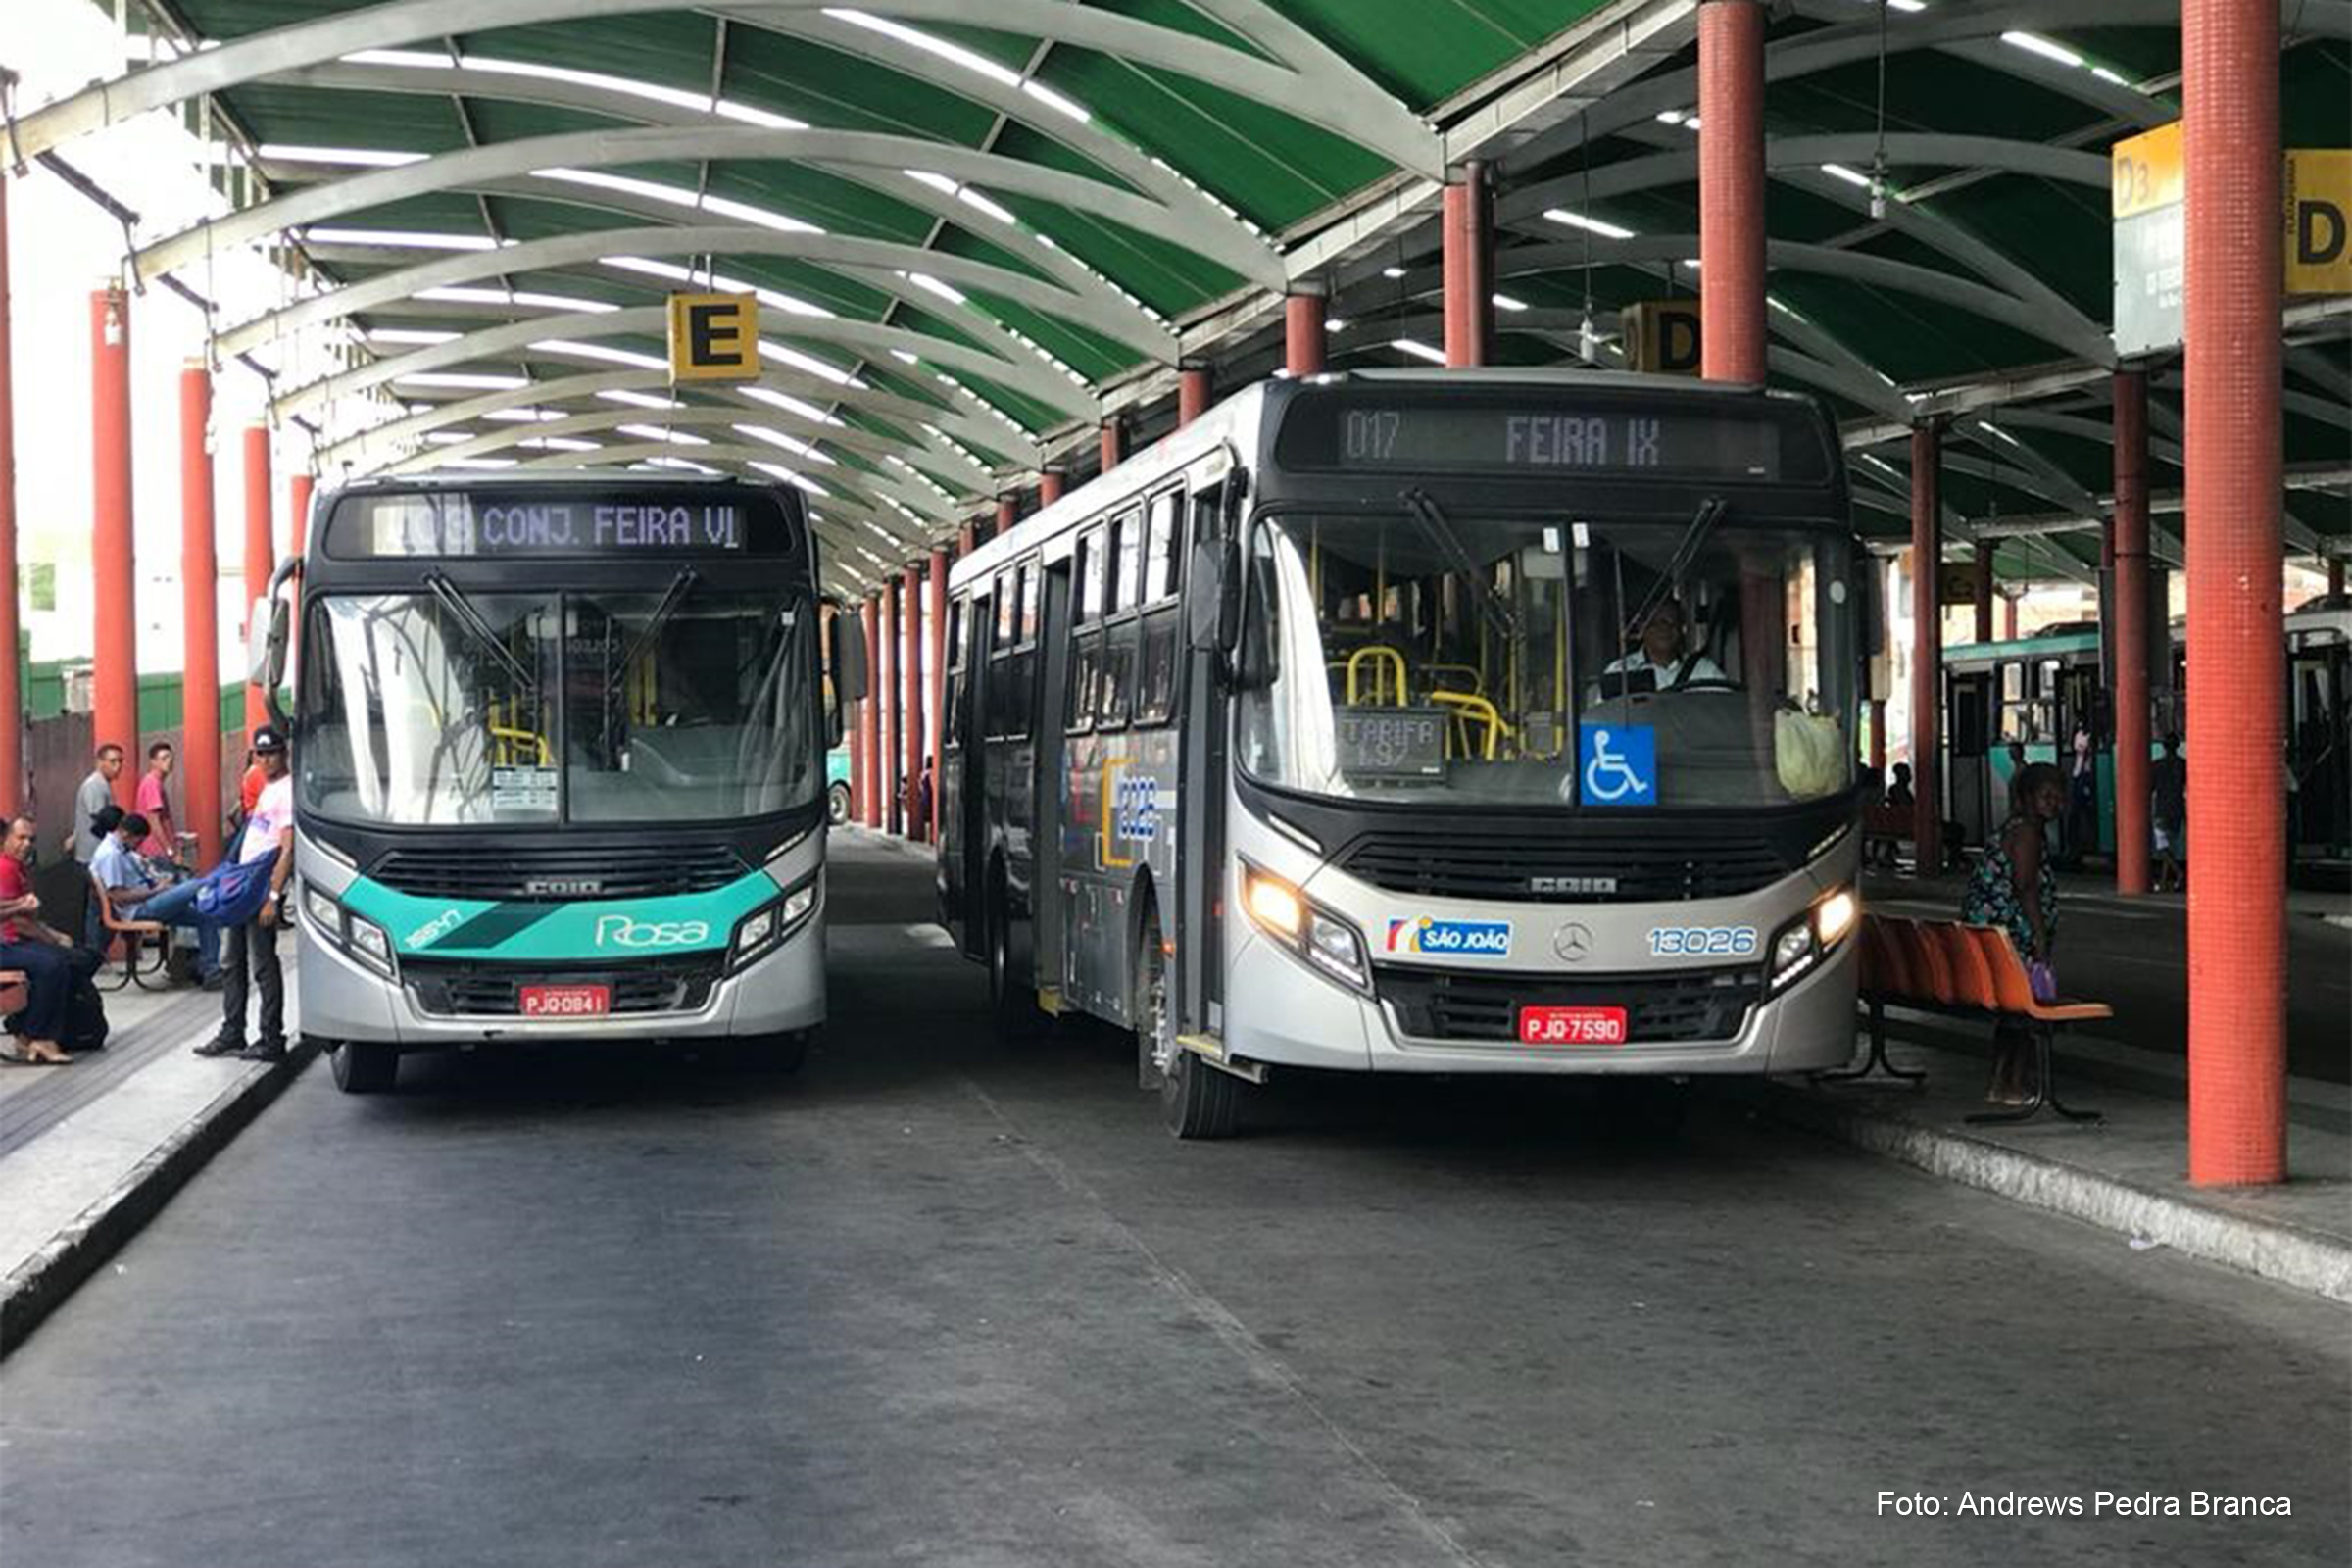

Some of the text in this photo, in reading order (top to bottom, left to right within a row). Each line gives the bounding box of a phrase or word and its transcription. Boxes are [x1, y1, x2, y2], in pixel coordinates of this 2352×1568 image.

[2298, 200, 2352, 265] D
[690, 304, 742, 366] E
[1348, 410, 1399, 459] 017
[1506, 416, 1660, 466] FEIRA IX
[484, 506, 580, 546] CONJ.
[594, 506, 690, 545] FEIRA
[705, 506, 735, 547] VI
[595, 913, 709, 948] Rosa
[1425, 926, 1509, 950] SÃO JOÃO
[1647, 927, 1757, 955] 13026
